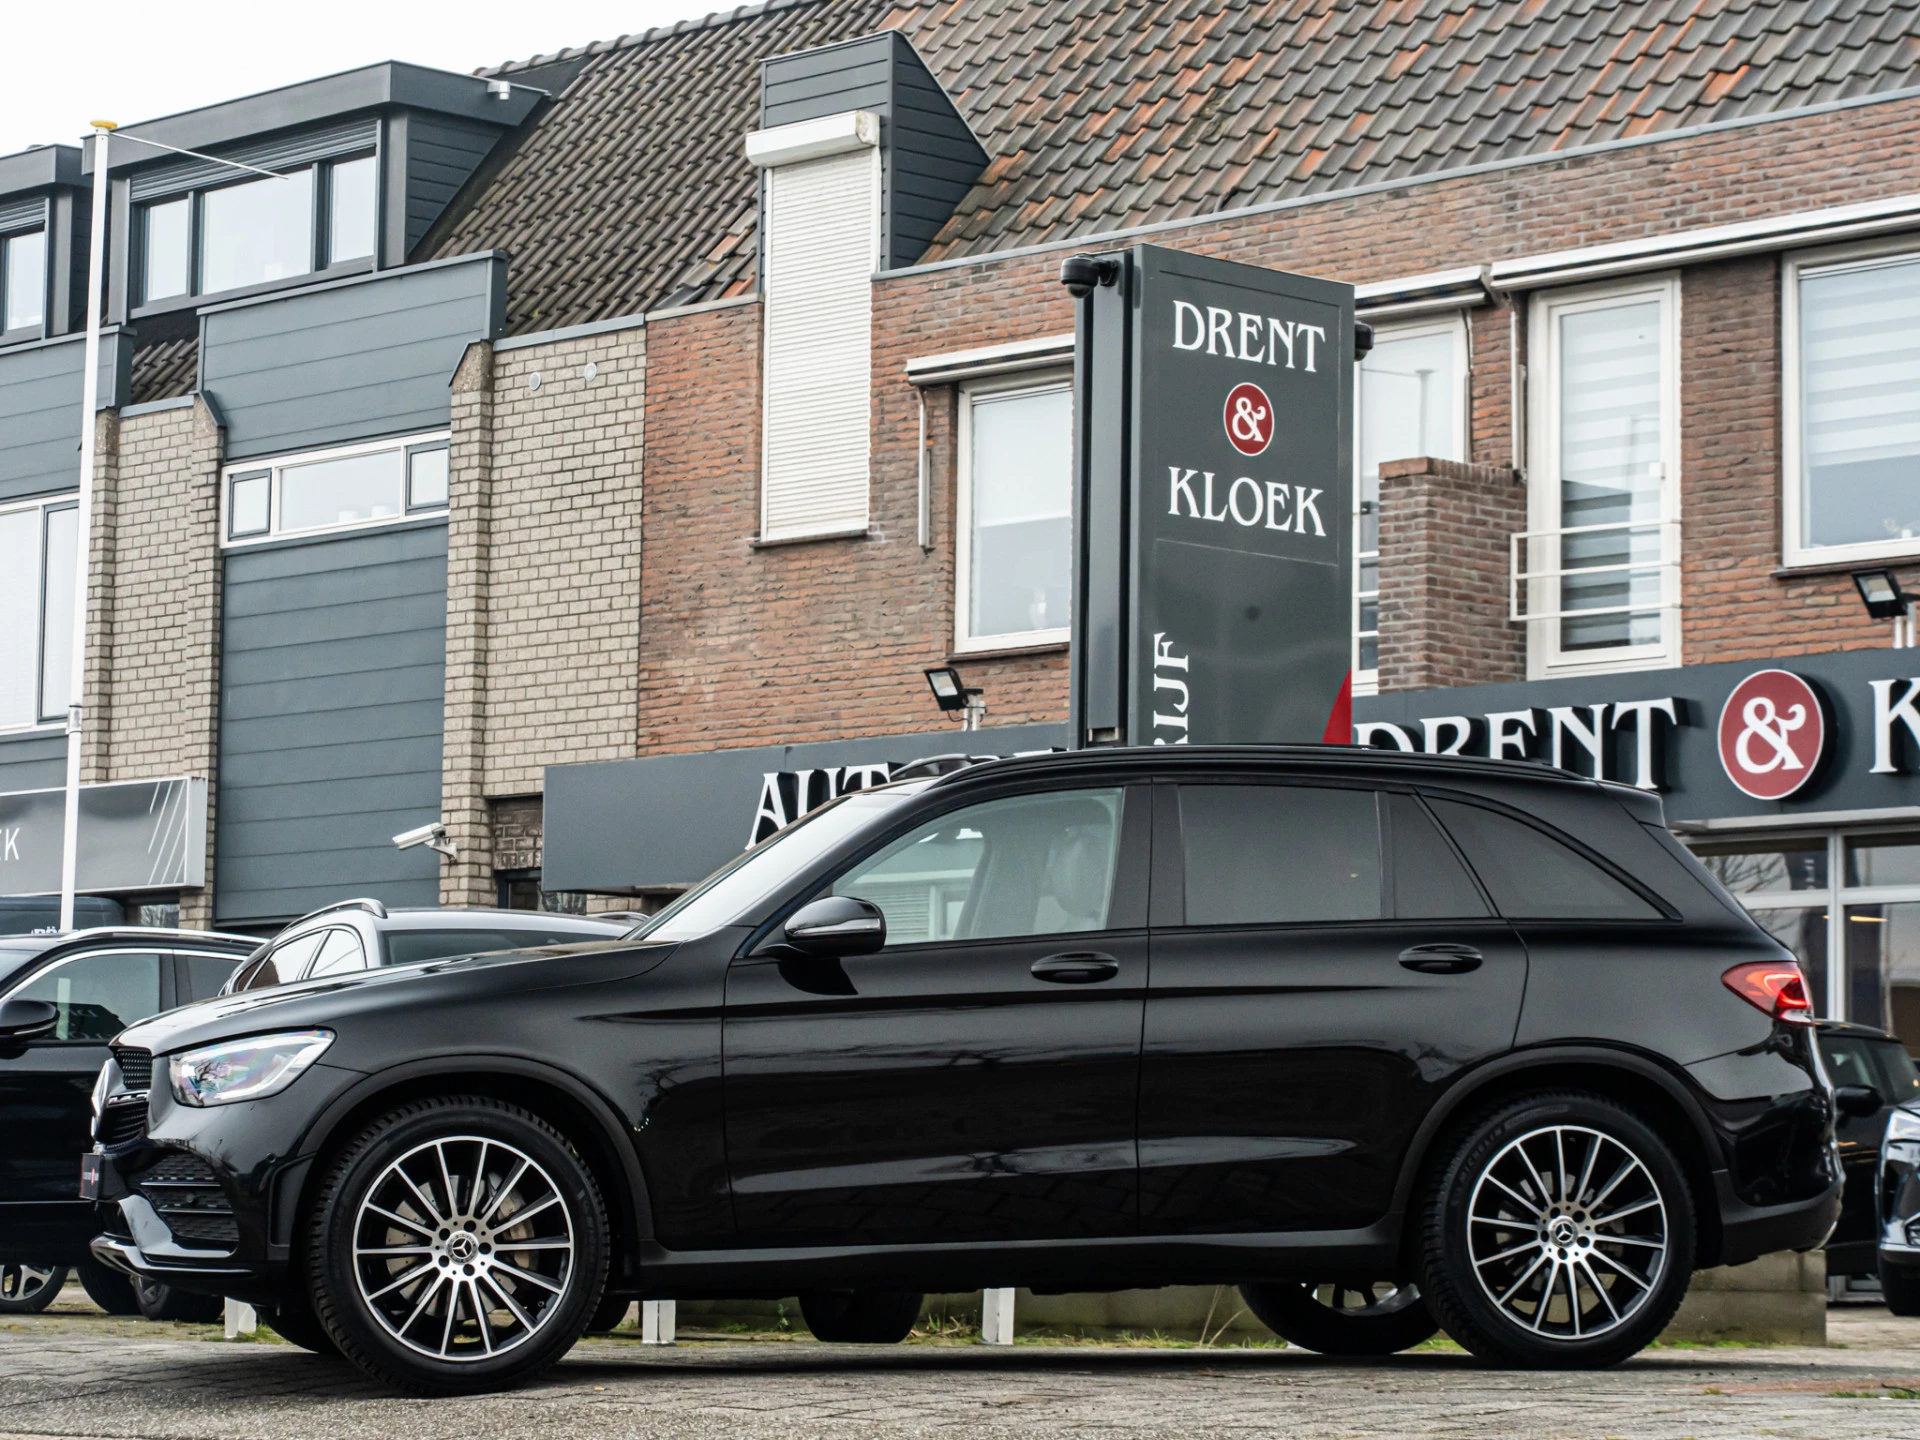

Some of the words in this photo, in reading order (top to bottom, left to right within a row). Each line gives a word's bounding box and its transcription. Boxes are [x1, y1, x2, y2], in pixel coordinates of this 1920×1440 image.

[1172, 300, 1326, 372] DRENT
[1231, 396, 1267, 443] &
[1168, 467, 1326, 537] KLOEK
[1153, 632, 1189, 745] IJF
[1735, 696, 1807, 774] &
[1867, 677, 1920, 773] K
[0, 827, 20, 861] K
